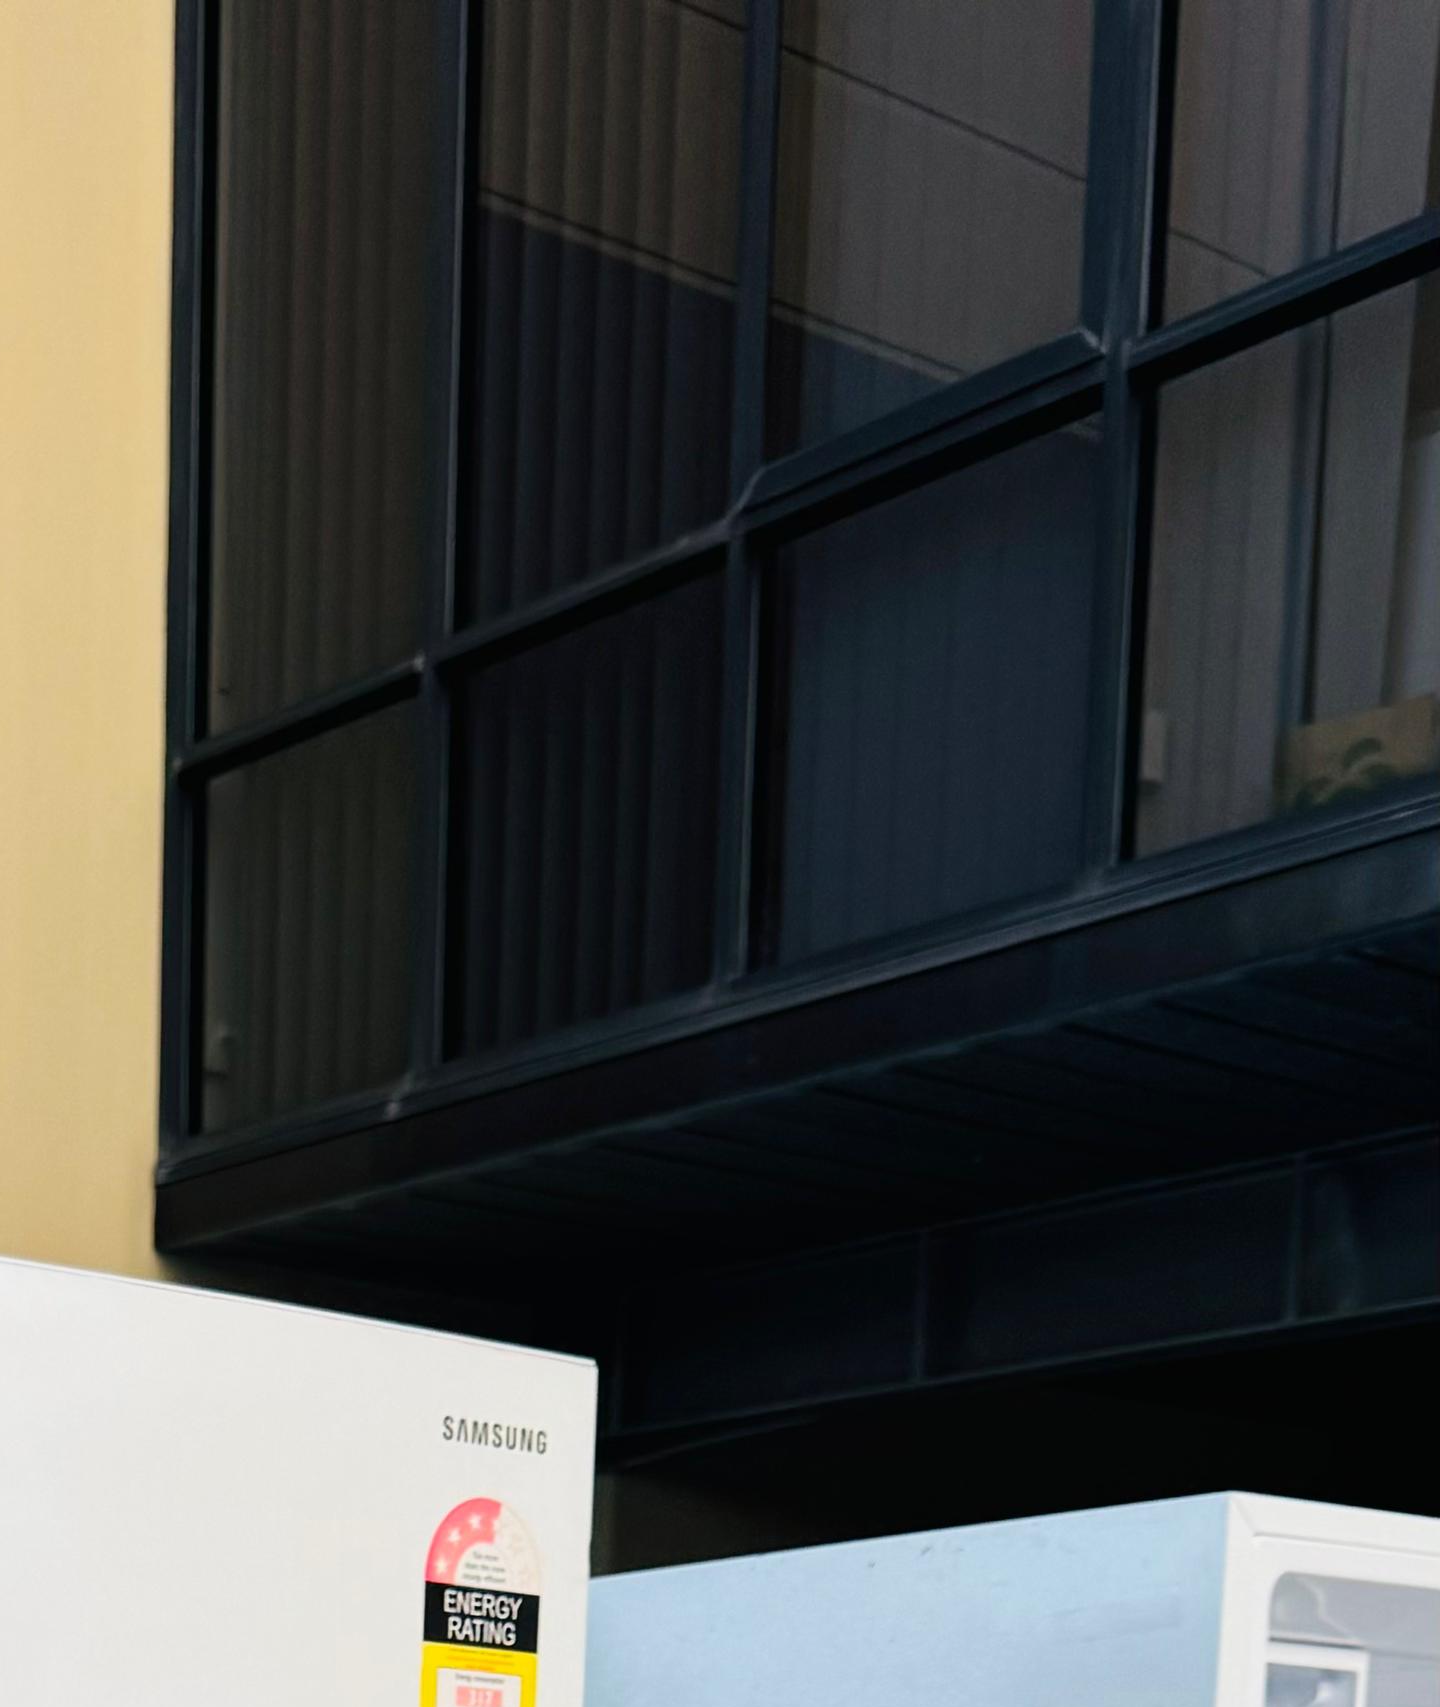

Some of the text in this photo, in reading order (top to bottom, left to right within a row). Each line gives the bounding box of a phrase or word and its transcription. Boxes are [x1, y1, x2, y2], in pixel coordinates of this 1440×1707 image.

[442, 1415, 547, 1455] SAMSUNG
[443, 1587, 523, 1621] ENERGY
[447, 1615, 517, 1647] RATING
